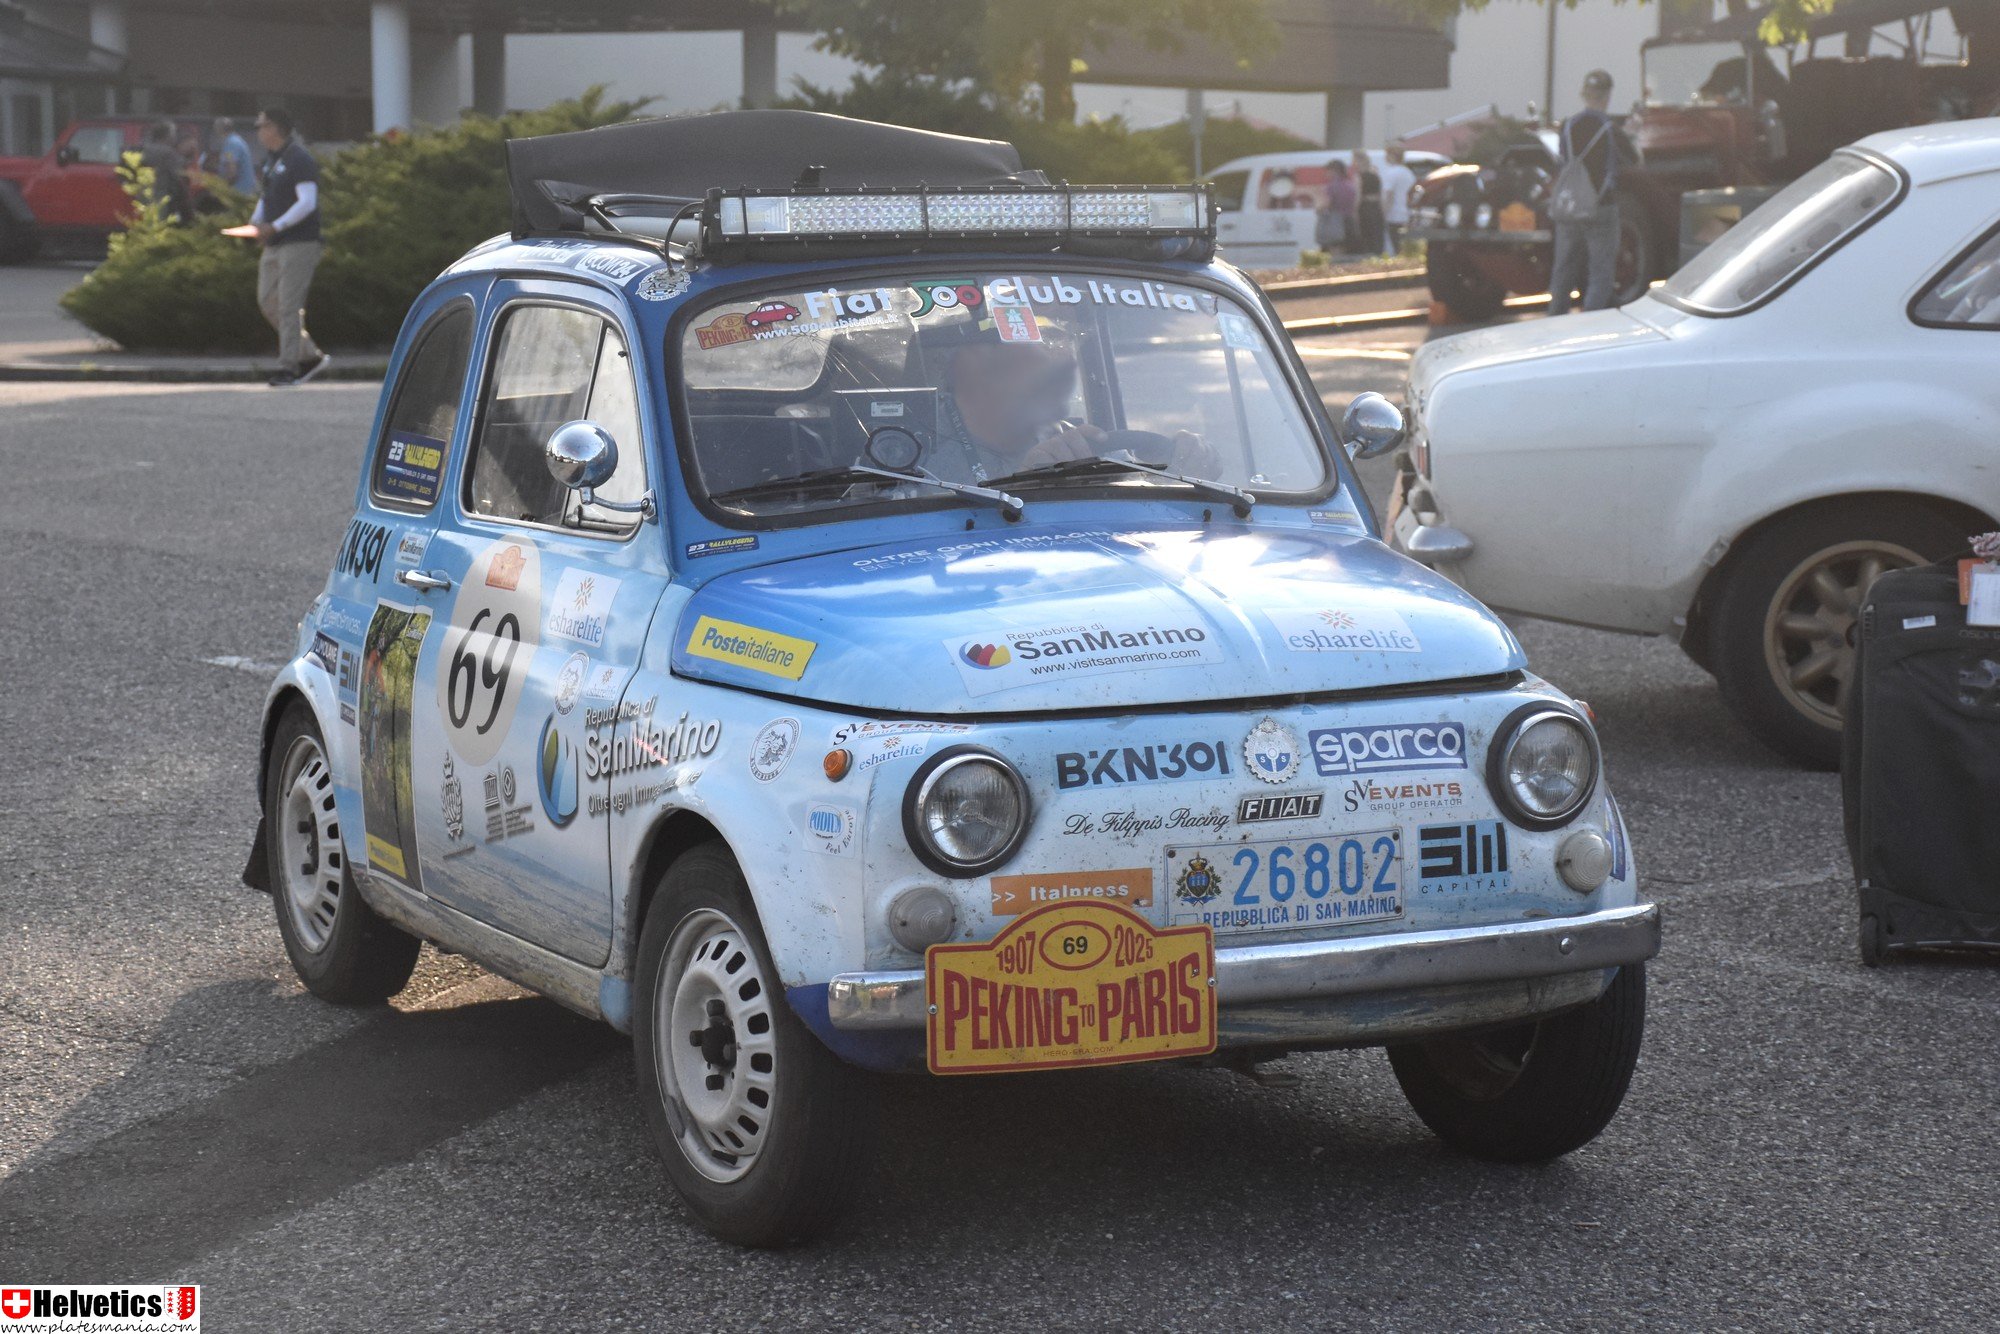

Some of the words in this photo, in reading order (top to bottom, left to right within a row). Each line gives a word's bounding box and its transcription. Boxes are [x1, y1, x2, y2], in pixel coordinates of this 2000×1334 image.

[804, 288, 893, 319] Fiat
[907, 279, 982, 318] 500
[989, 276, 1082, 305] Club
[1088, 279, 1197, 311] Italia
[1009, 323, 1029, 338] 25
[852, 550, 932, 567] OLTRE
[936, 540, 999, 553] OGNI
[550, 608, 602, 644] esharelife
[1006, 623, 1087, 642] Repubblica
[1092, 622, 1104, 631] di
[1289, 629, 1415, 649] esharelife
[701, 627, 794, 667] Posteitaliane
[1014, 626, 1206, 660] SanMarino
[447, 608, 520, 735] 69
[1030, 647, 1202, 675] www.visitsanmarino.com
[585, 699, 640, 727] Repubblica
[643, 693, 658, 714] di
[585, 711, 721, 778] SanMarino
[858, 743, 924, 771] esharelife
[1315, 727, 1462, 772] sparco
[588, 794, 609, 814] Oltre
[1369, 782, 1462, 800] EVENTS
[1370, 802, 1405, 811] GROUP
[1410, 799, 1462, 809] OPERATOR
[1063, 813, 1094, 836] De
[1165, 807, 1230, 832] Racing
[1244, 797, 1321, 819] FIAT
[1232, 836, 1397, 906] 26802
[1421, 878, 1509, 895] CAPITAL
[1203, 908, 1290, 929] REPUBBLICA
[1296, 904, 1309, 922] DI
[1316, 902, 1341, 919] SAN
[1349, 896, 1396, 916] MARINO
[996, 931, 1036, 975] 1907
[1063, 936, 1088, 955] 69
[1114, 924, 1153, 967] 2025
[943, 968, 1079, 1051] PEKING
[1080, 1003, 1095, 1028] TO
[1098, 952, 1201, 1042] PARIS
